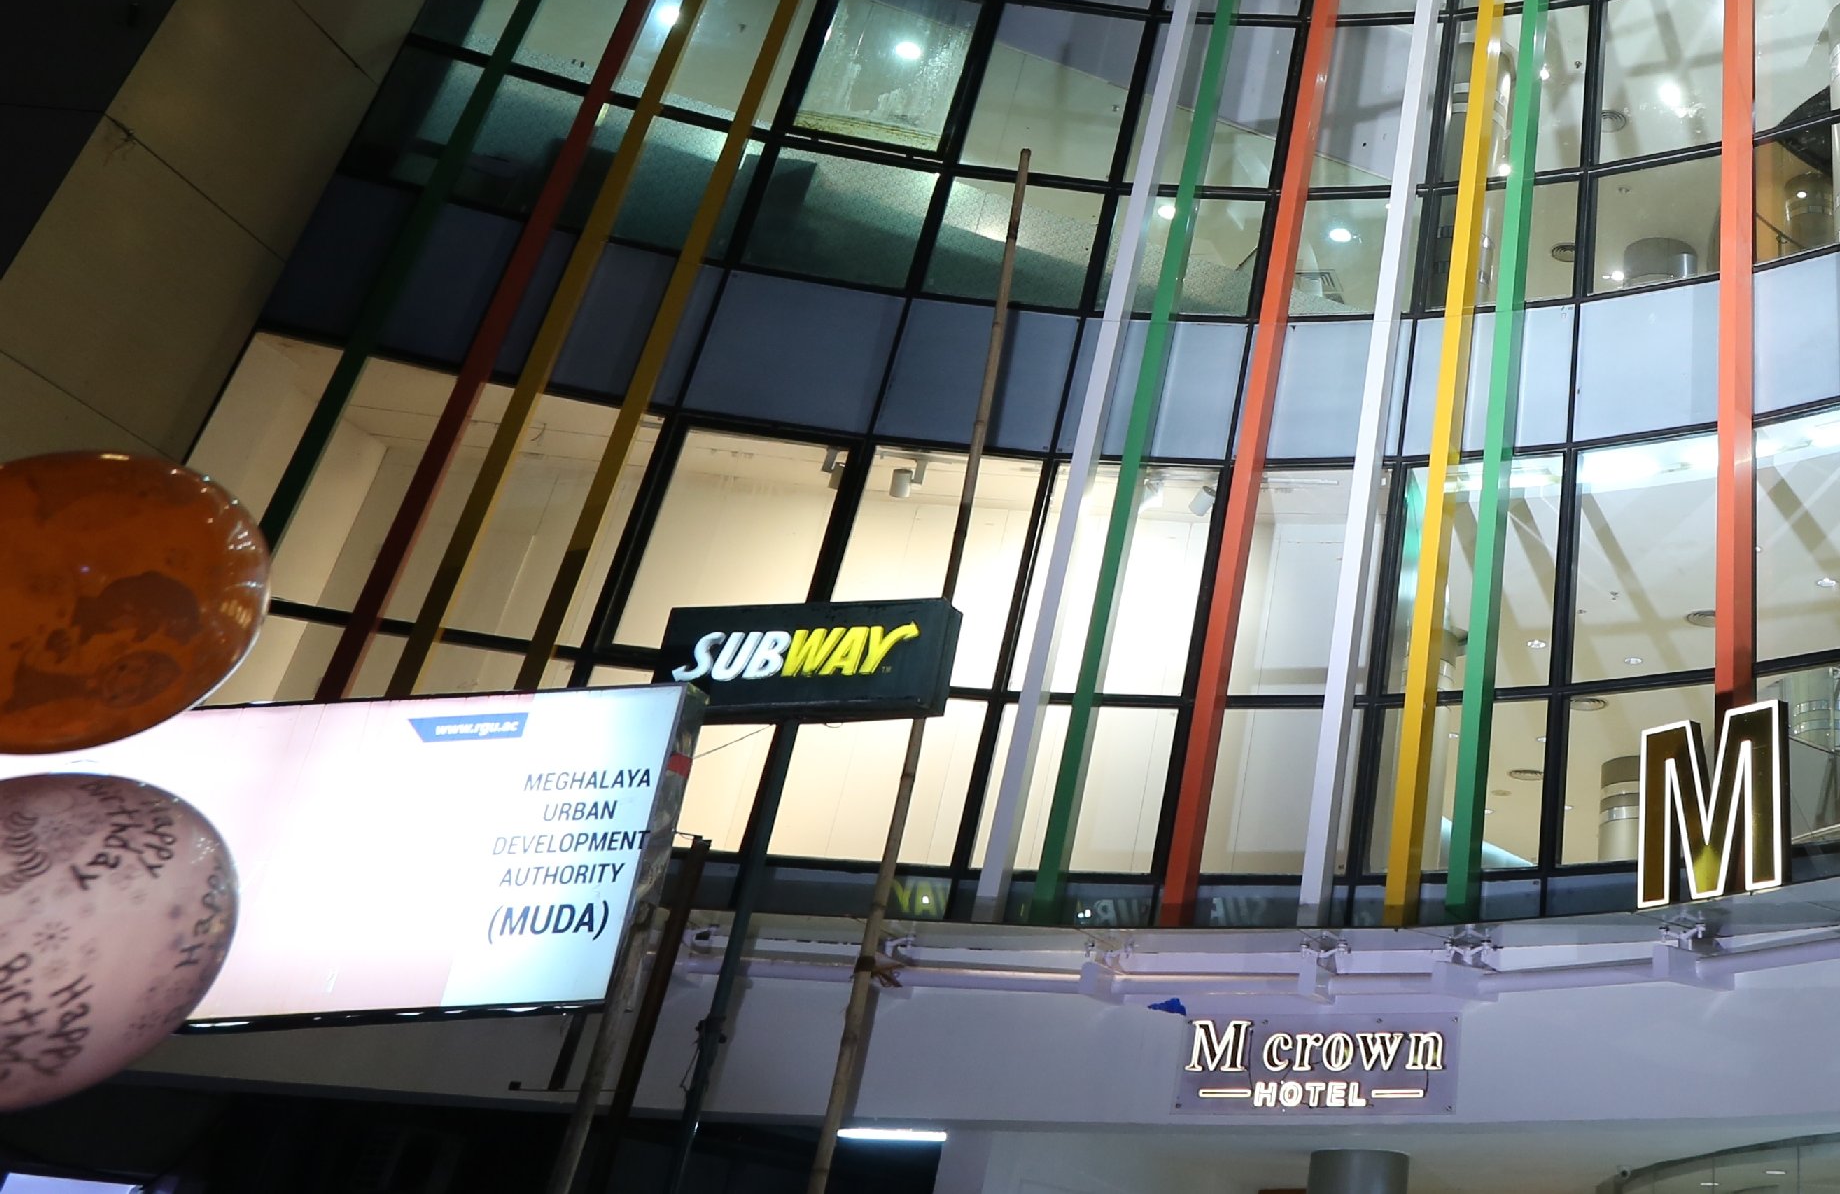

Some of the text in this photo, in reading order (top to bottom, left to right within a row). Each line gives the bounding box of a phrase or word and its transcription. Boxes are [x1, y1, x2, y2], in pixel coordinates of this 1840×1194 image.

[671, 621, 920, 682] SUBWAY
[523, 768, 651, 792] MEGHALAYA
[542, 800, 617, 822] URBAN
[492, 830, 651, 856] DEVELOPMENT
[499, 862, 626, 887] AUTHORITY
[487, 900, 609, 945] (MUDA)
[1185, 1019, 1447, 1072] M crown
[1253, 1081, 1367, 1107] HOTEL
